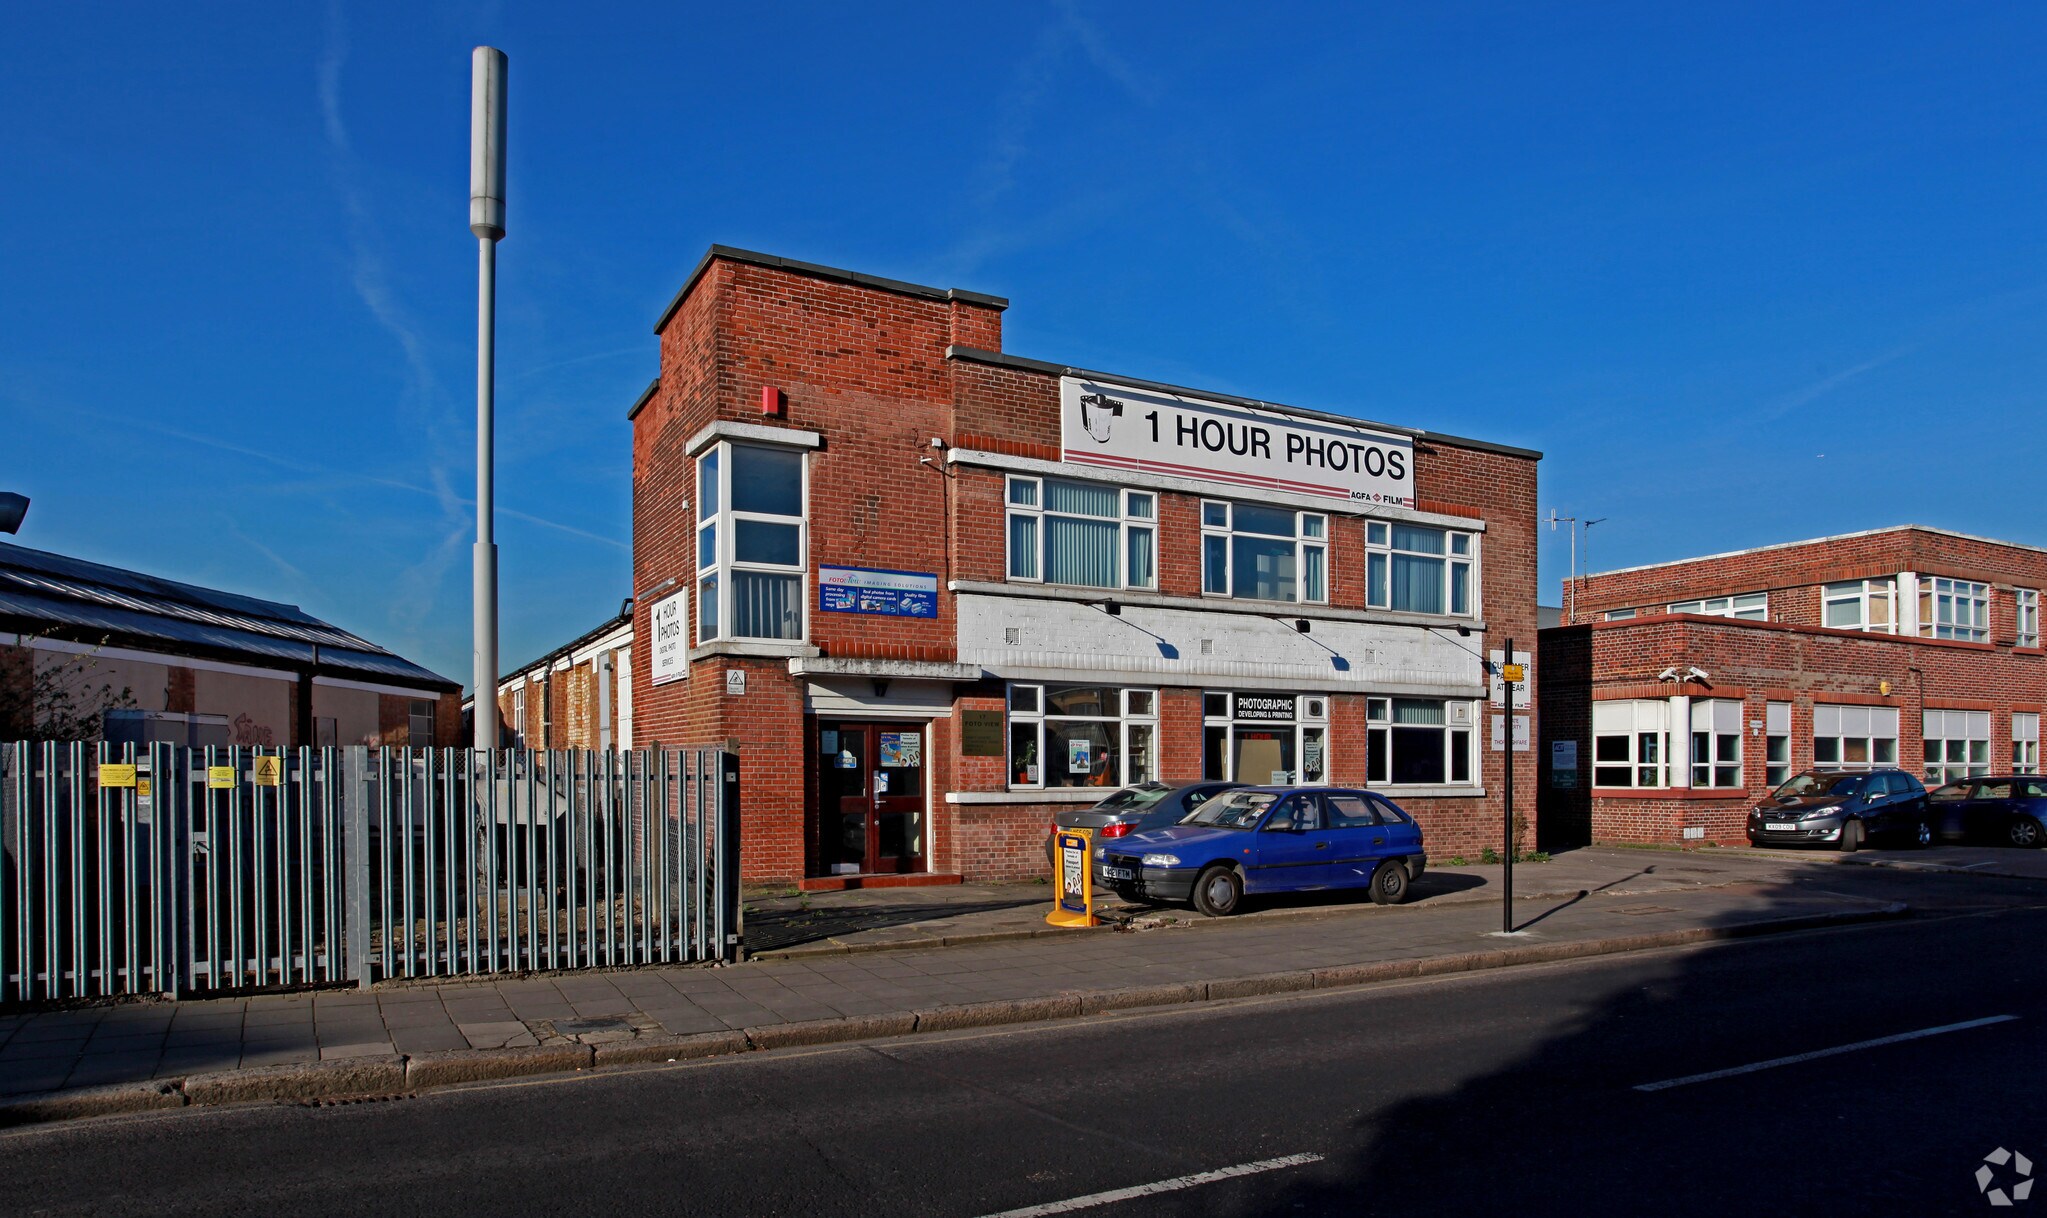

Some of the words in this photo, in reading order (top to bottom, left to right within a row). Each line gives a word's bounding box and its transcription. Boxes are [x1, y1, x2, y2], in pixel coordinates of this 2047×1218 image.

[1144, 410, 1159, 443] 1
[1176, 414, 1271, 460] HOUR
[1286, 433, 1406, 481] PHOTOS
[1350, 491, 1371, 501] AGFA
[1383, 495, 1403, 505] FILM
[894, 582, 927, 590] SOLUTIONS
[656, 608, 661, 643] 1
[663, 600, 677, 620] HOUR
[661, 620, 680, 641] PHOTOS
[668, 641, 677, 652] PHOTO
[1492, 661, 1529, 671] CUMER
[1496, 683, 1505, 691] AT
[1511, 684, 1525, 692] EAR
[1238, 697, 1293, 711] PHOTOGRAPHIC
[1238, 710, 1268, 718] DEVELOPING
[1272, 711, 1293, 719] PRINTING
[964, 720, 983, 728] FOTO
